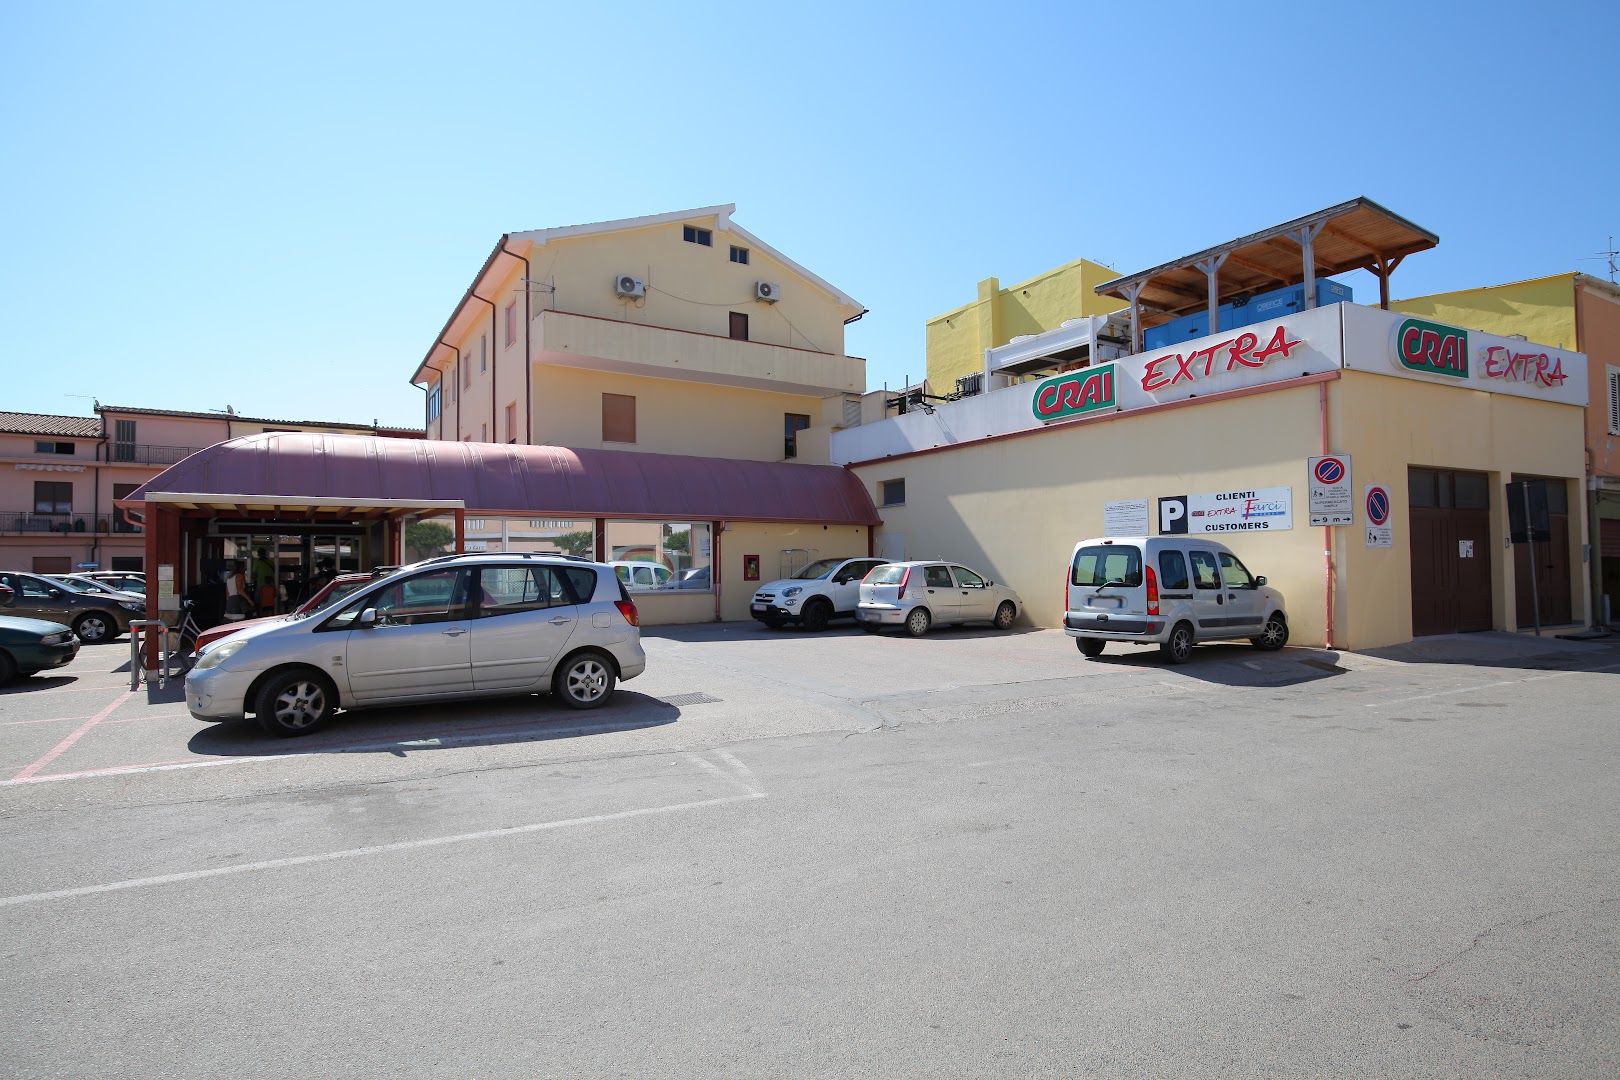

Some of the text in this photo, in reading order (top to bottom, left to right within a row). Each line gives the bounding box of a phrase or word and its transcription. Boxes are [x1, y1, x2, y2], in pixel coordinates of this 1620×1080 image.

[1402, 326, 1569, 387] CRAI EXTRA
[1037, 325, 1302, 415] CRAI EXTRA
[1215, 491, 1256, 501] CLIENTI
[1161, 500, 1185, 532] P
[1207, 507, 1238, 518] EXTRA
[1205, 521, 1270, 532] CUSTOMERS
